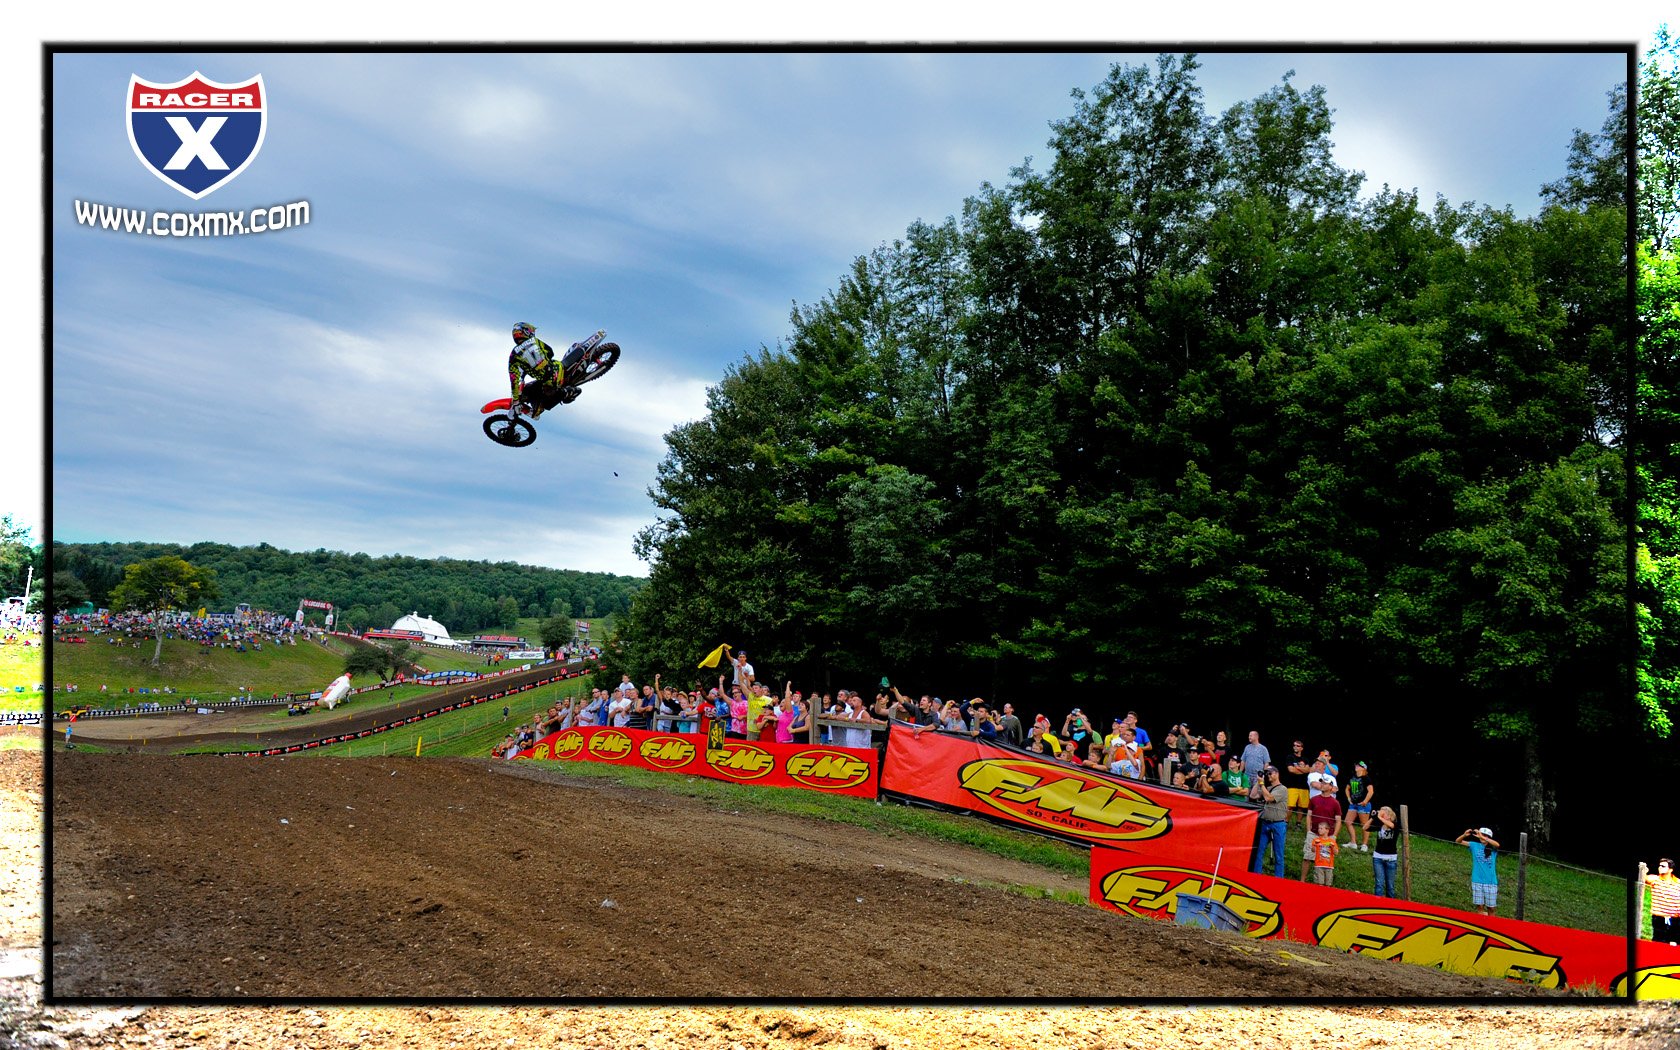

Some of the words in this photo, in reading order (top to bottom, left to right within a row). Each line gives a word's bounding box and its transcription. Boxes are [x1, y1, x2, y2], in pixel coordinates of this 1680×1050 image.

[555, 733, 584, 754] FMF
[588, 734, 632, 753] FMF
[640, 741, 695, 761] FMF
[706, 748, 774, 772] FMF
[786, 755, 869, 780] FMF
[960, 763, 1172, 829] FMF
[1026, 808, 1047, 819] SO.
[1051, 814, 1093, 831] CALIF.
[1317, 914, 1562, 981] FMF
